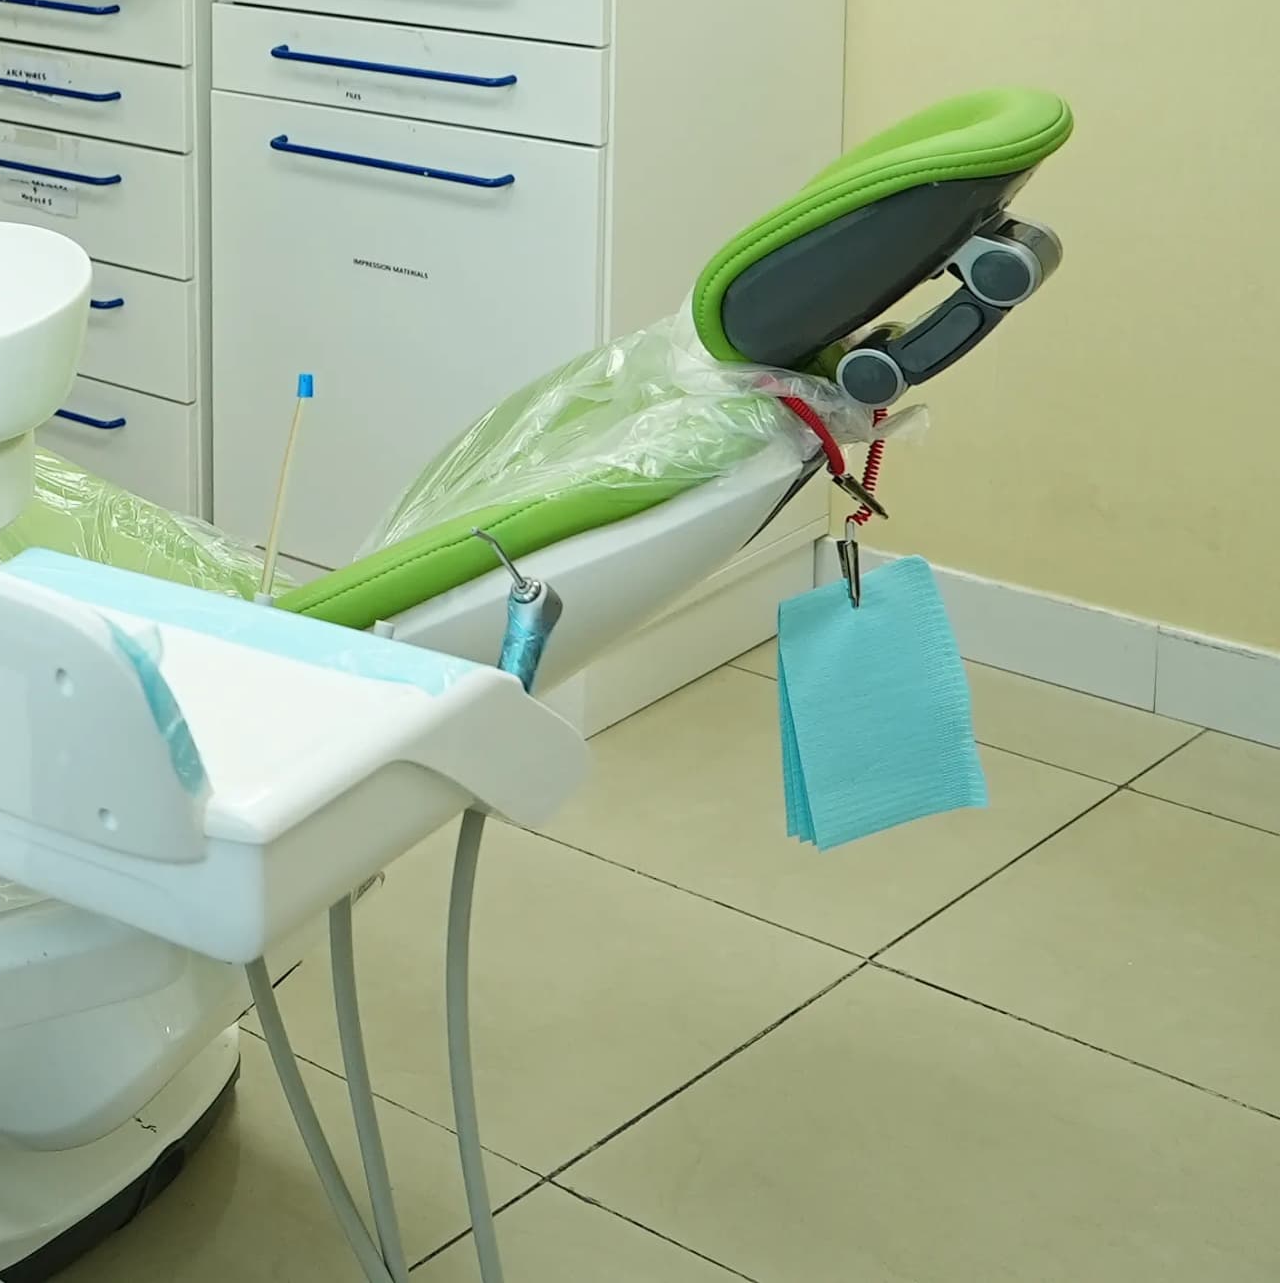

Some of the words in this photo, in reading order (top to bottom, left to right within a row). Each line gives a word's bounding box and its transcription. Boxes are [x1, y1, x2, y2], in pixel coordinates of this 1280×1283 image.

[346, 91, 361, 100] FILES
[353, 258, 391, 271] IMPRESSION
[393, 266, 428, 279] MATERIALS
